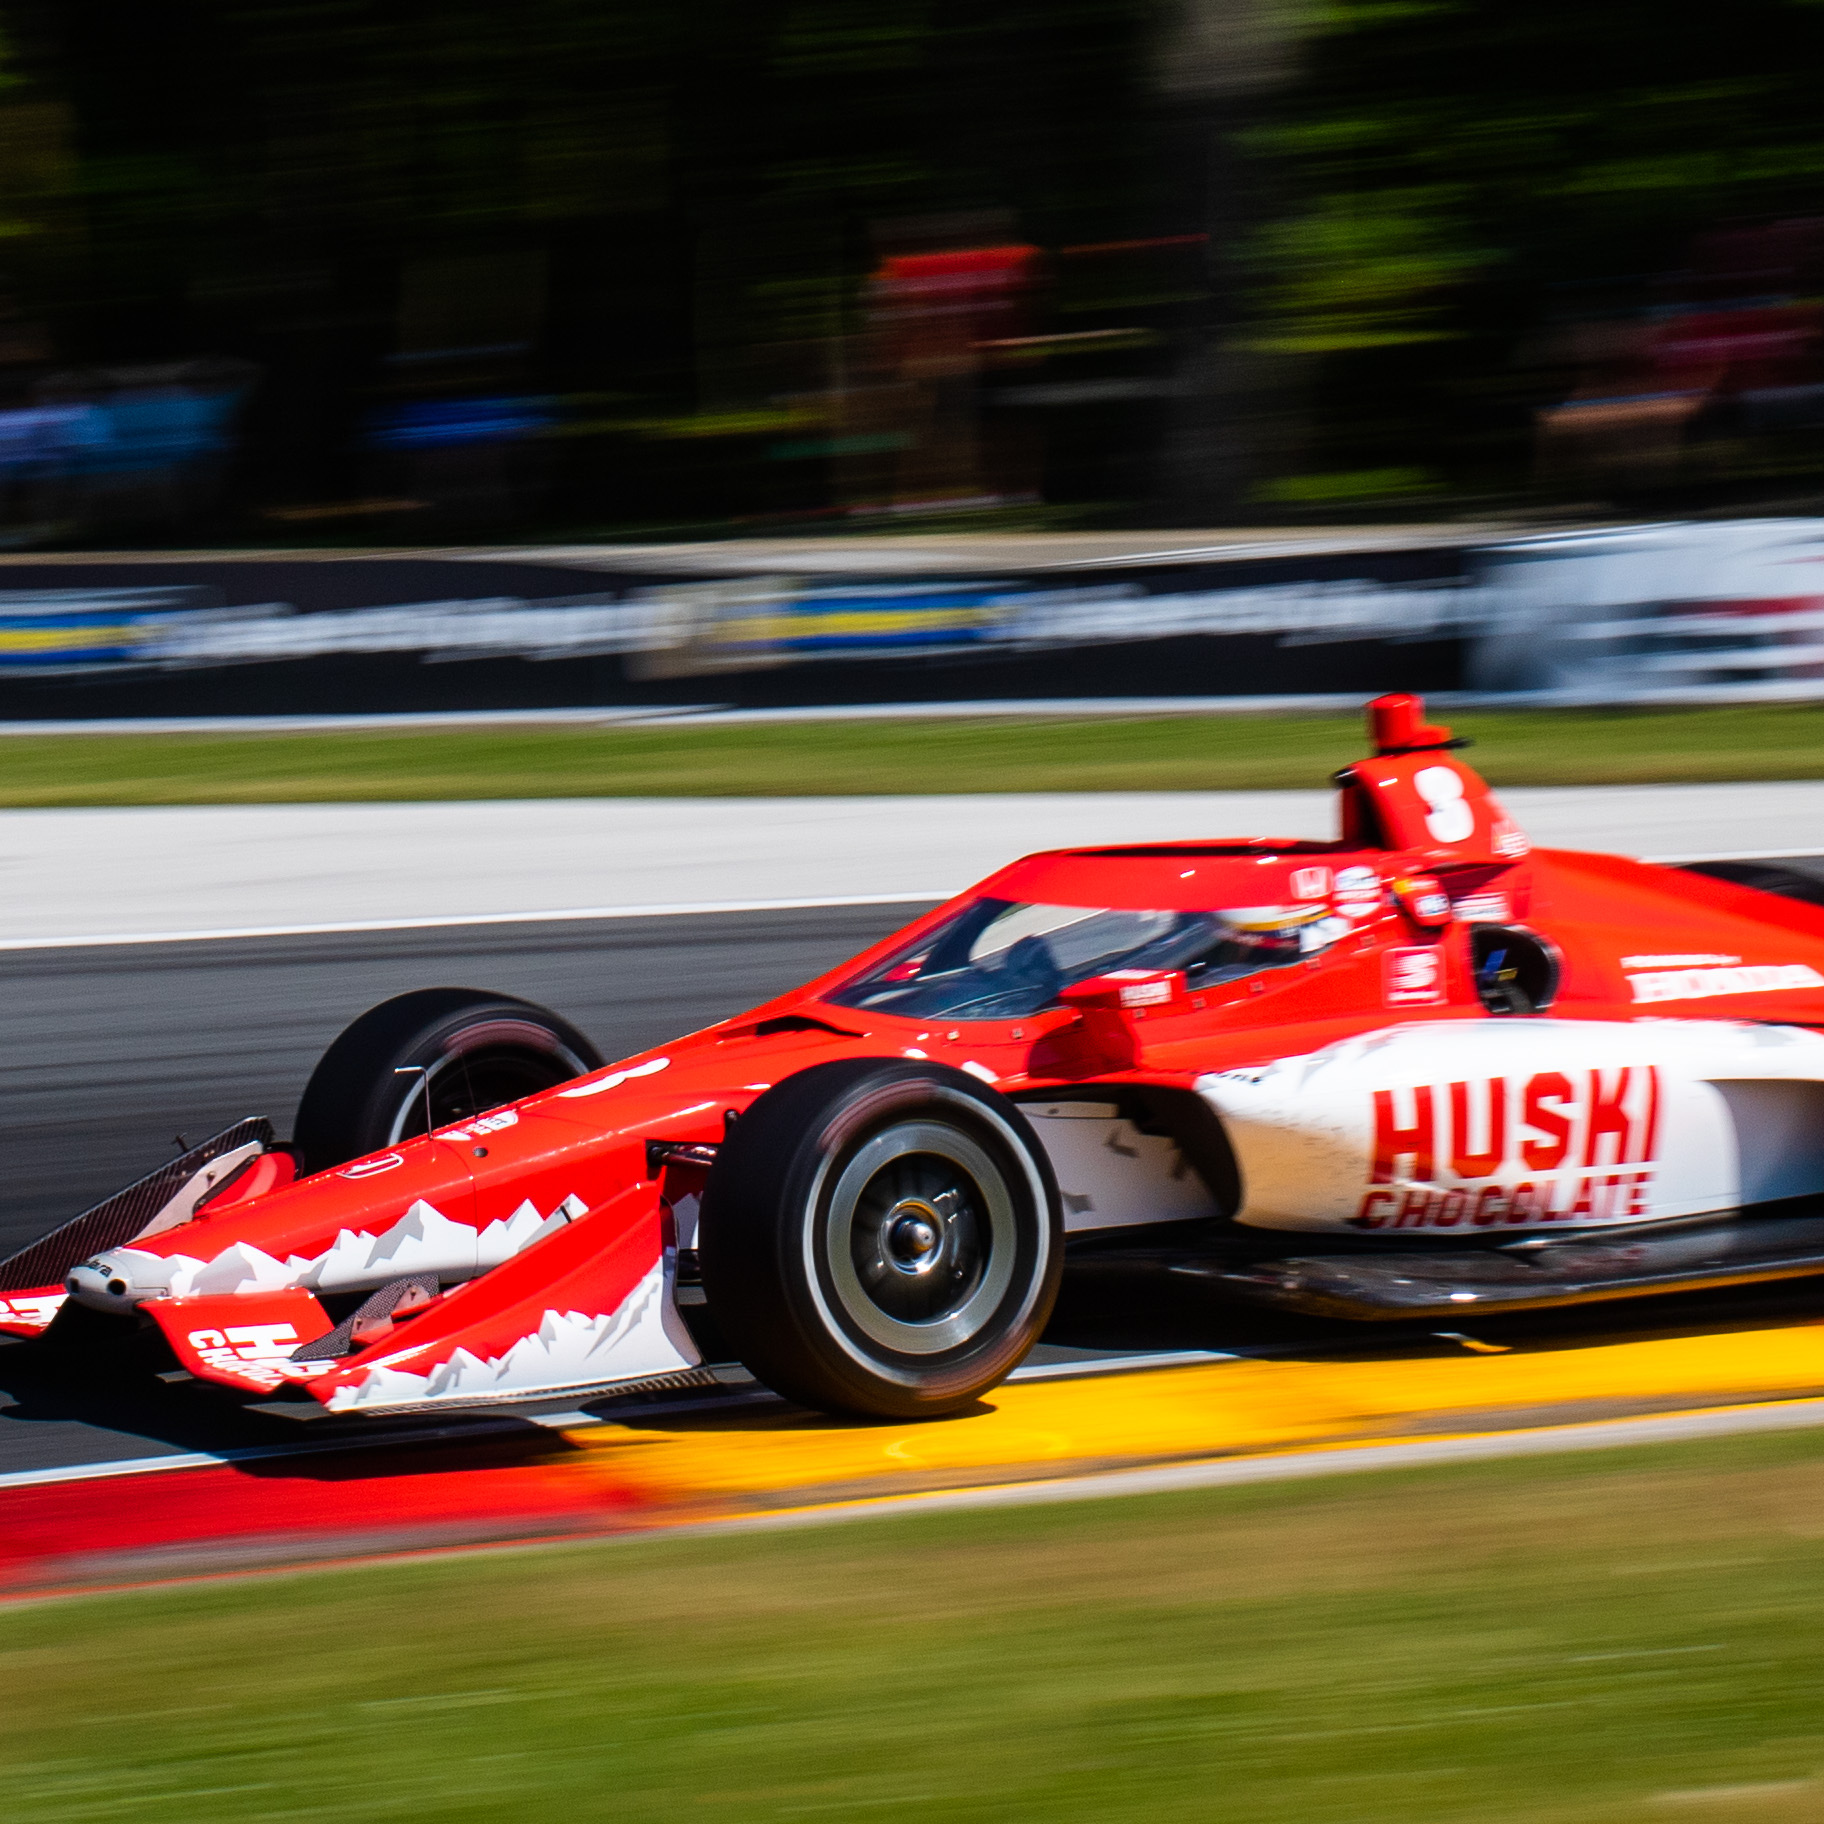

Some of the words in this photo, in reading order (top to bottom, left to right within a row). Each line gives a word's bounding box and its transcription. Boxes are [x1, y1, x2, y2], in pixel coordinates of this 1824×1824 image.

[1413, 765, 1475, 843] 8
[1368, 1064, 1665, 1185] HUSKI
[1356, 1171, 1658, 1230] CHOCOLATE
